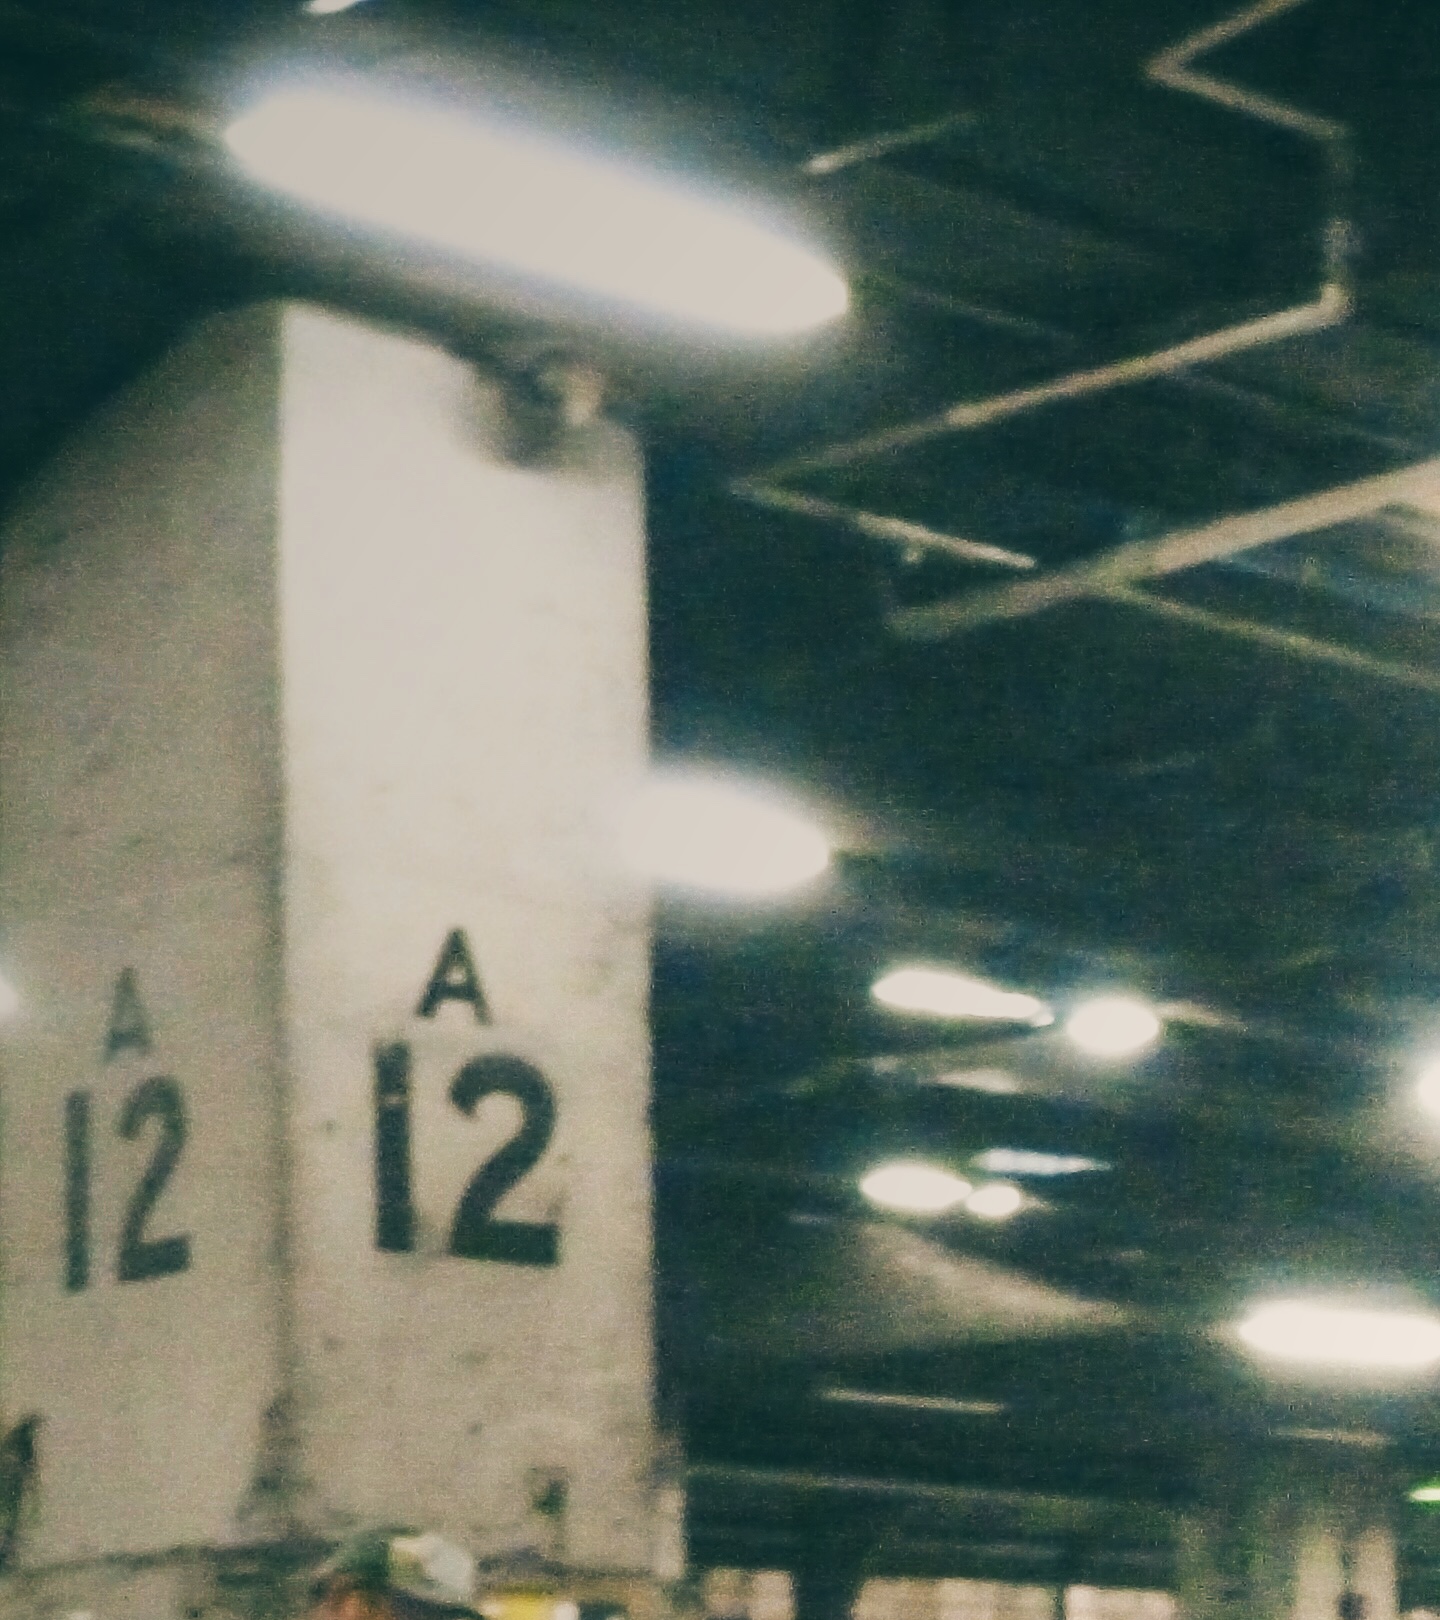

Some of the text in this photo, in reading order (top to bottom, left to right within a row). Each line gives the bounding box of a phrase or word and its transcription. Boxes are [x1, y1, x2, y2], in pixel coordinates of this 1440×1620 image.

[103, 966, 153, 1063] A
[415, 926, 494, 1025] A
[63, 1074, 192, 1292] 12
[373, 1040, 561, 1267] 12
